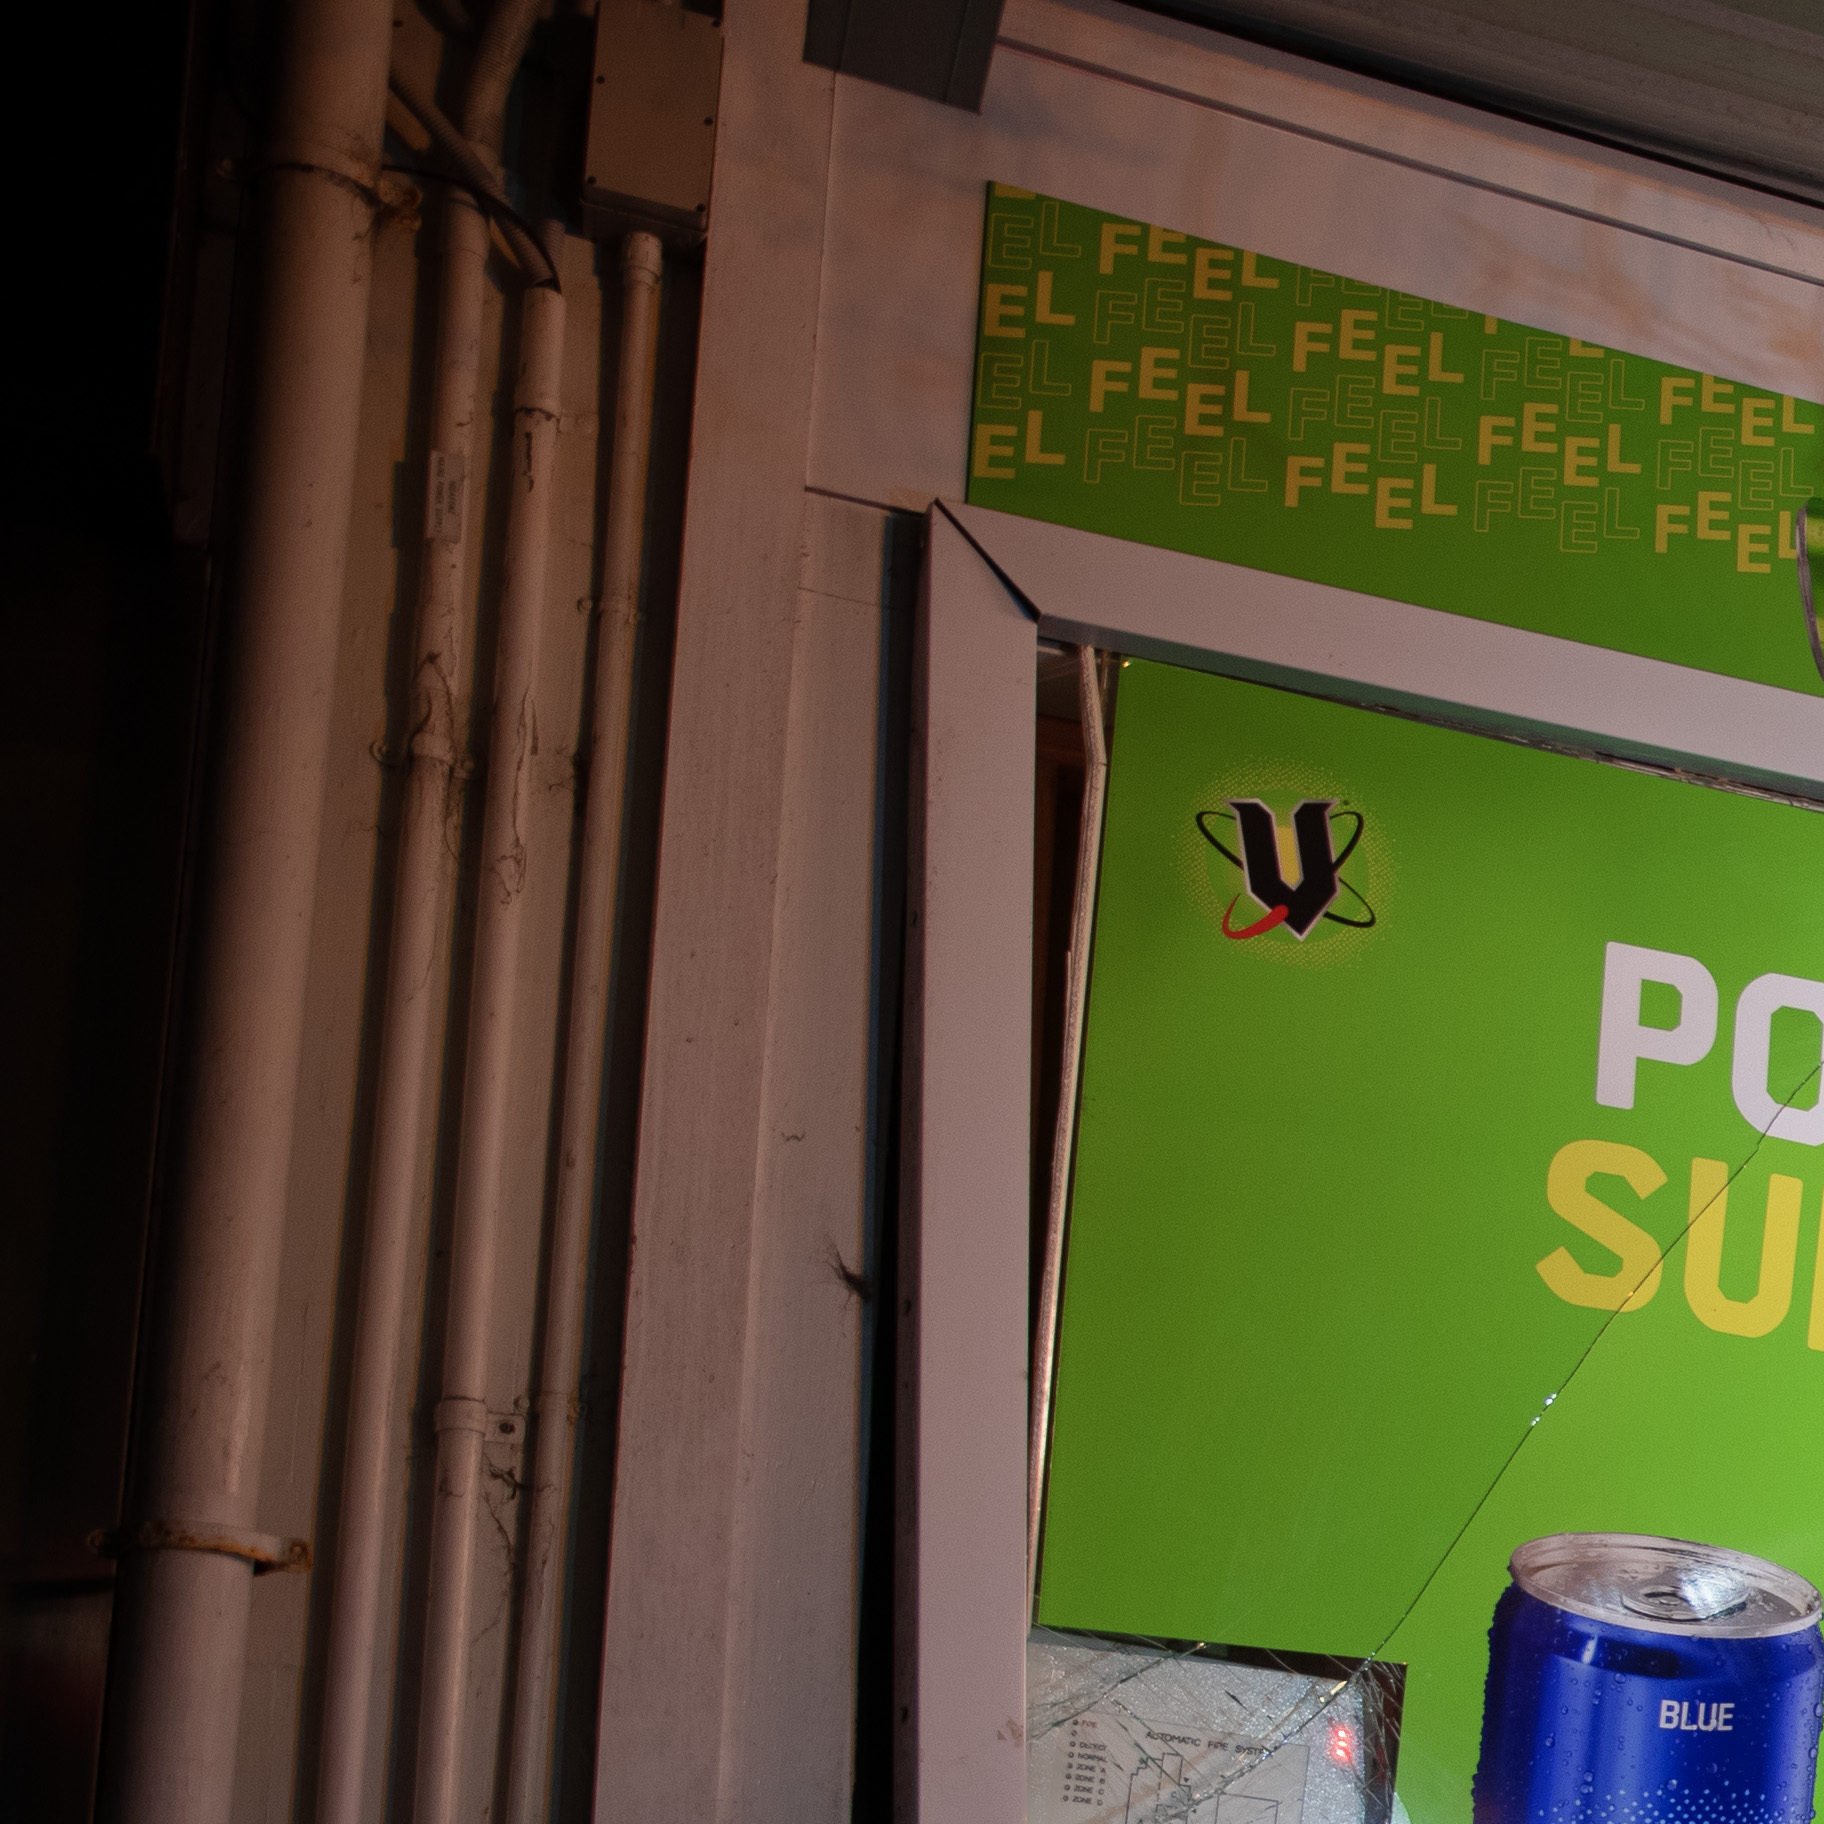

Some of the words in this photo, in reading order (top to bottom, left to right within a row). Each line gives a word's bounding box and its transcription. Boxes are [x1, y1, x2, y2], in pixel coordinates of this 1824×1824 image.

[988, 201, 1081, 270] EL
[984, 270, 1075, 338] EL
[1094, 278, 1276, 370] FEEL
[977, 339, 1071, 410] EL
[1089, 346, 1271, 437] FEEL
[1293, 309, 1464, 396] FEEL
[1480, 337, 1645, 423] FEEL
[973, 410, 1066, 479] EL
[1084, 414, 1268, 506] FEEL
[1288, 374, 1462, 463] FEEL
[1477, 402, 1642, 487] FEEL
[1284, 442, 1458, 529] FEEL
[1474, 467, 1640, 553] FEEL
[1657, 426, 1814, 510] FEEL
[1225, 798, 1341, 941] V
[1659, 1700, 1734, 1731] BLUE
